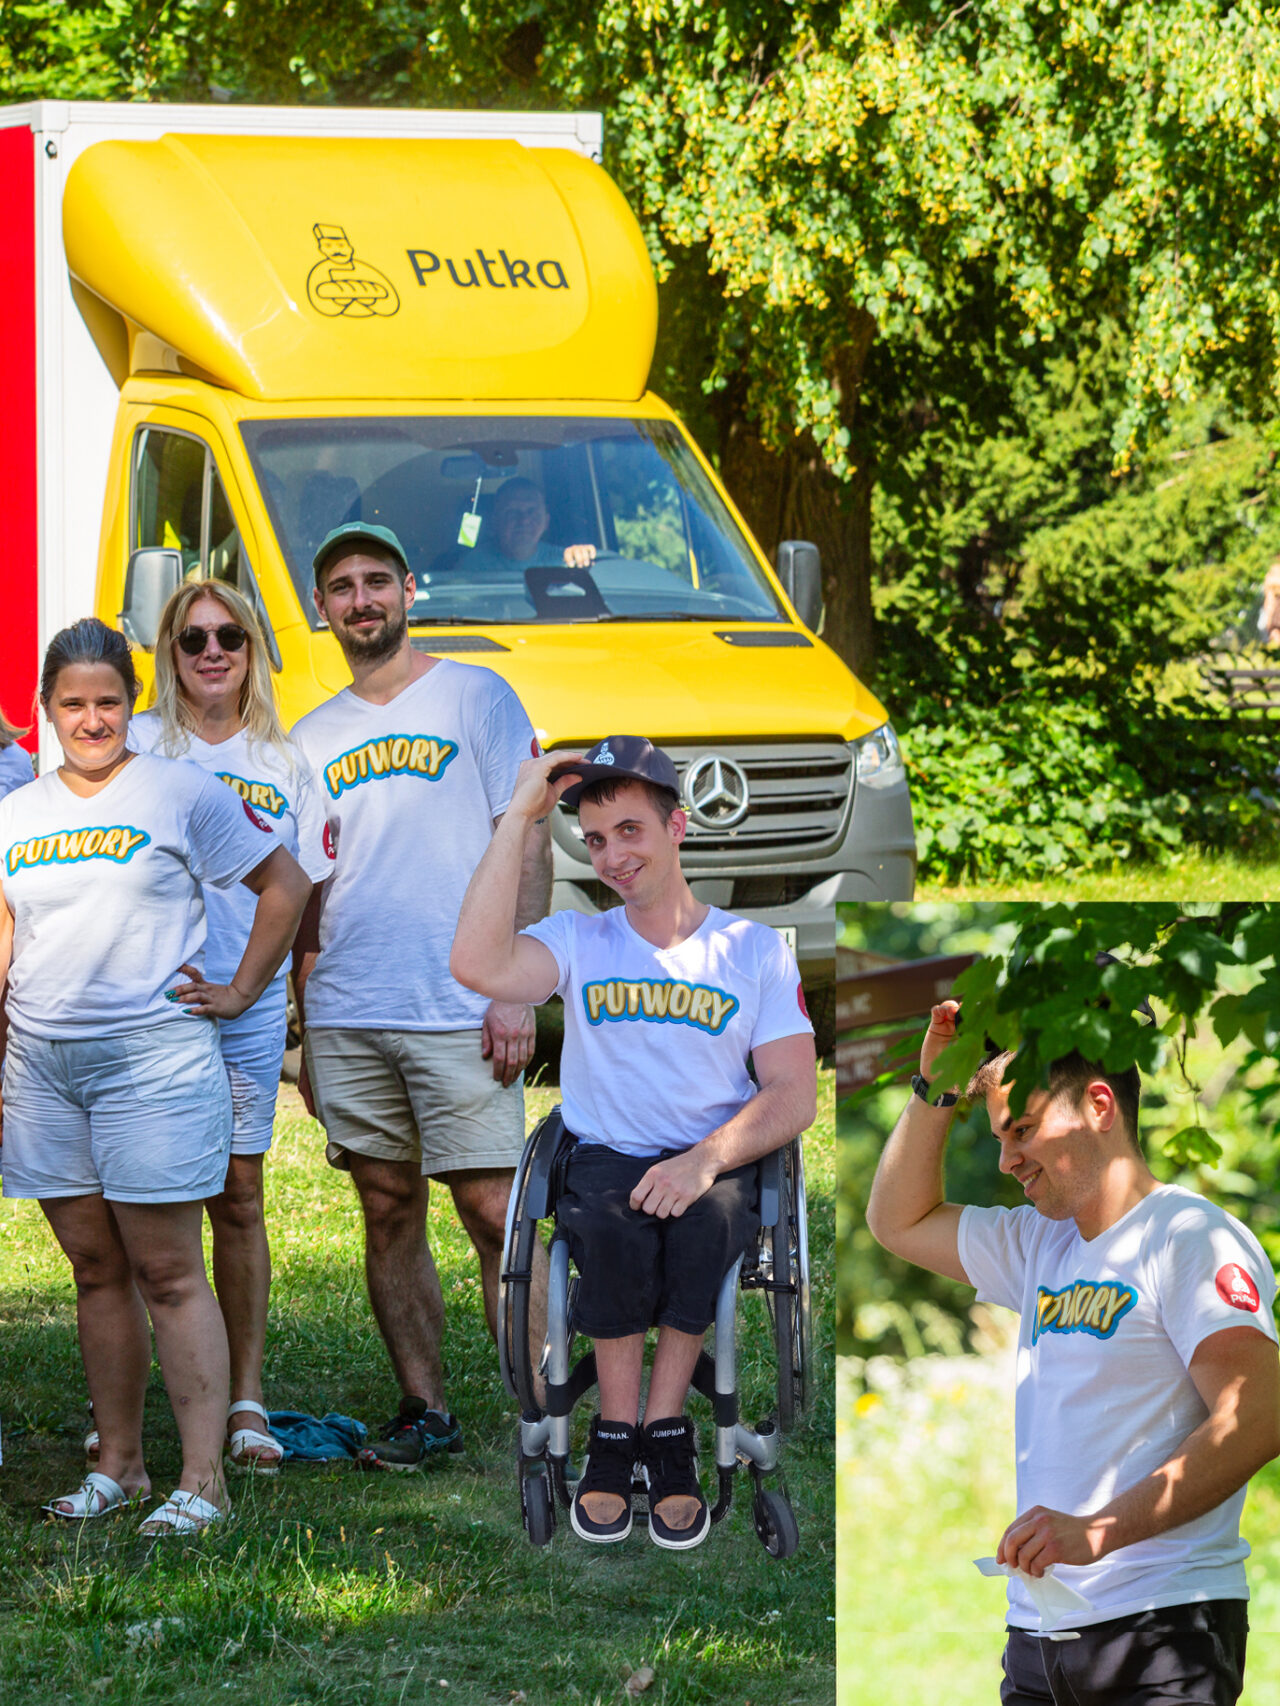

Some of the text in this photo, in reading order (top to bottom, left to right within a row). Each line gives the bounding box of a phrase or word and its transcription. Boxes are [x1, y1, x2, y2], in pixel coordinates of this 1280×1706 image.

[406, 249, 570, 289] Putka
[326, 737, 453, 795] PUTWORY
[8, 827, 145, 872] PUTWORY
[587, 981, 734, 1030] PUTWORY
